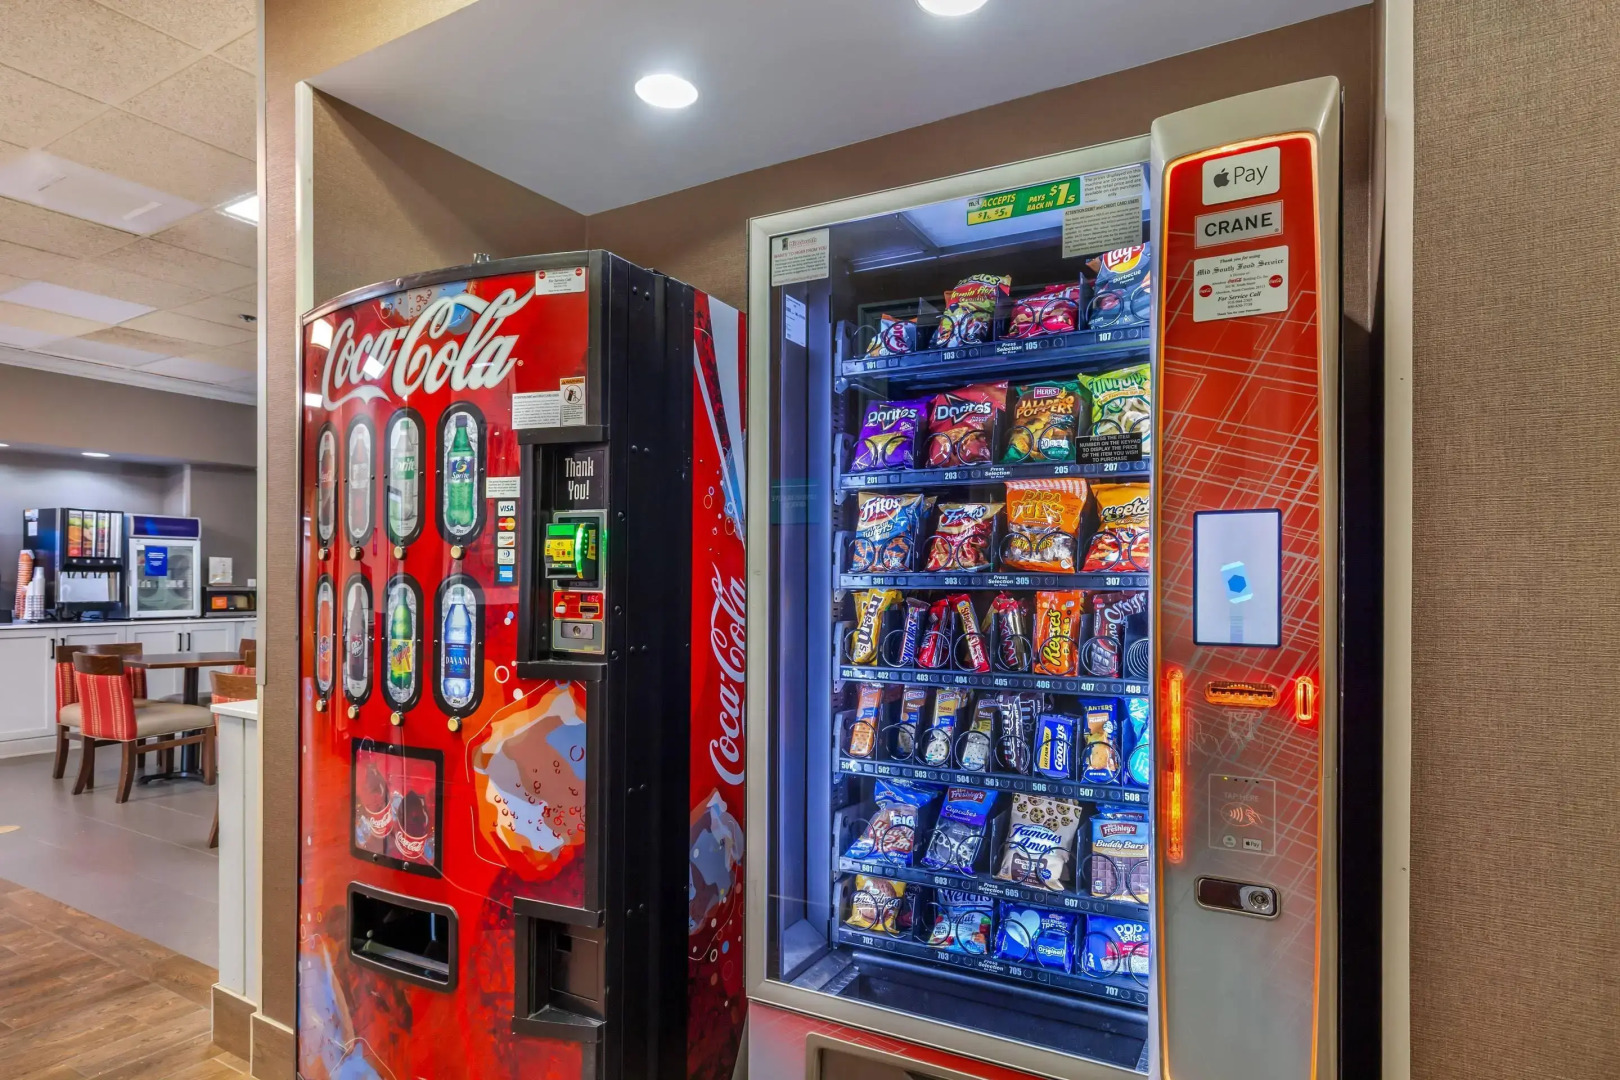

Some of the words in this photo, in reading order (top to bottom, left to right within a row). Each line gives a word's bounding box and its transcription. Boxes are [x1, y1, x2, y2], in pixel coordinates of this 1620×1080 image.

[1234, 166, 1268, 185] Pay
[981, 193, 1016, 208] ACCEPTS
[1029, 194, 1046, 203] PAYS
[1027, 202, 1044, 211] BACK
[1045, 200, 1054, 209] IN
[1204, 212, 1273, 237] CRANE
[1212, 266, 1235, 274] South
[1257, 259, 1284, 267] Service
[1113, 270, 1141, 283] Barbecue
[1099, 333, 1111, 341] 107
[322, 288, 536, 411] Coca-Cola
[1025, 342, 1037, 350] 105
[944, 352, 954, 360] 103
[868, 408, 917, 422] Doritos
[937, 402, 992, 420] Doritos
[1016, 405, 1073, 419] POPPERS
[565, 456, 594, 478] Thank
[1054, 466, 1068, 474] 205
[1104, 463, 1117, 471] 207
[451, 472, 470, 480] Sprite
[944, 472, 957, 480] 203
[568, 479, 590, 501] You!
[500, 504, 515, 513] VISA
[861, 497, 900, 521] Fritos
[1016, 577, 1029, 585] 305
[445, 656, 470, 665] DASANI
[710, 562, 745, 786] Coca-Cola
[955, 676, 967, 684] 404
[1081, 683, 1094, 691] 407
[1126, 685, 1141, 694] 408
[878, 766, 890, 774] 502
[914, 770, 927, 778] 503
[957, 775, 969, 783] 504
[986, 778, 999, 786] 505
[1033, 783, 1046, 791] 506
[1080, 788, 1093, 796] 507
[1125, 794, 1140, 802] 508
[945, 805, 978, 818] Cupcakes
[893, 815, 915, 827] BIG
[1009, 823, 1062, 844] Famous
[1103, 826, 1135, 834] Freshley's
[397, 833, 425, 852] Coca-Cola
[1009, 837, 1055, 854] Amos
[1096, 840, 1123, 849] Buddy
[1125, 841, 1144, 850] Bars
[862, 865, 873, 873] 601
[935, 877, 948, 885] 603
[978, 886, 1004, 894] Selection
[1005, 889, 1019, 898] 605
[1064, 899, 1078, 908] 607
[863, 937, 873, 945] 702
[1121, 932, 1142, 943] tarts
[1038, 945, 1063, 957] Original
[978, 962, 1004, 971] Selection
[1009, 966, 1021, 976] 705
[1106, 986, 1118, 996] 707
